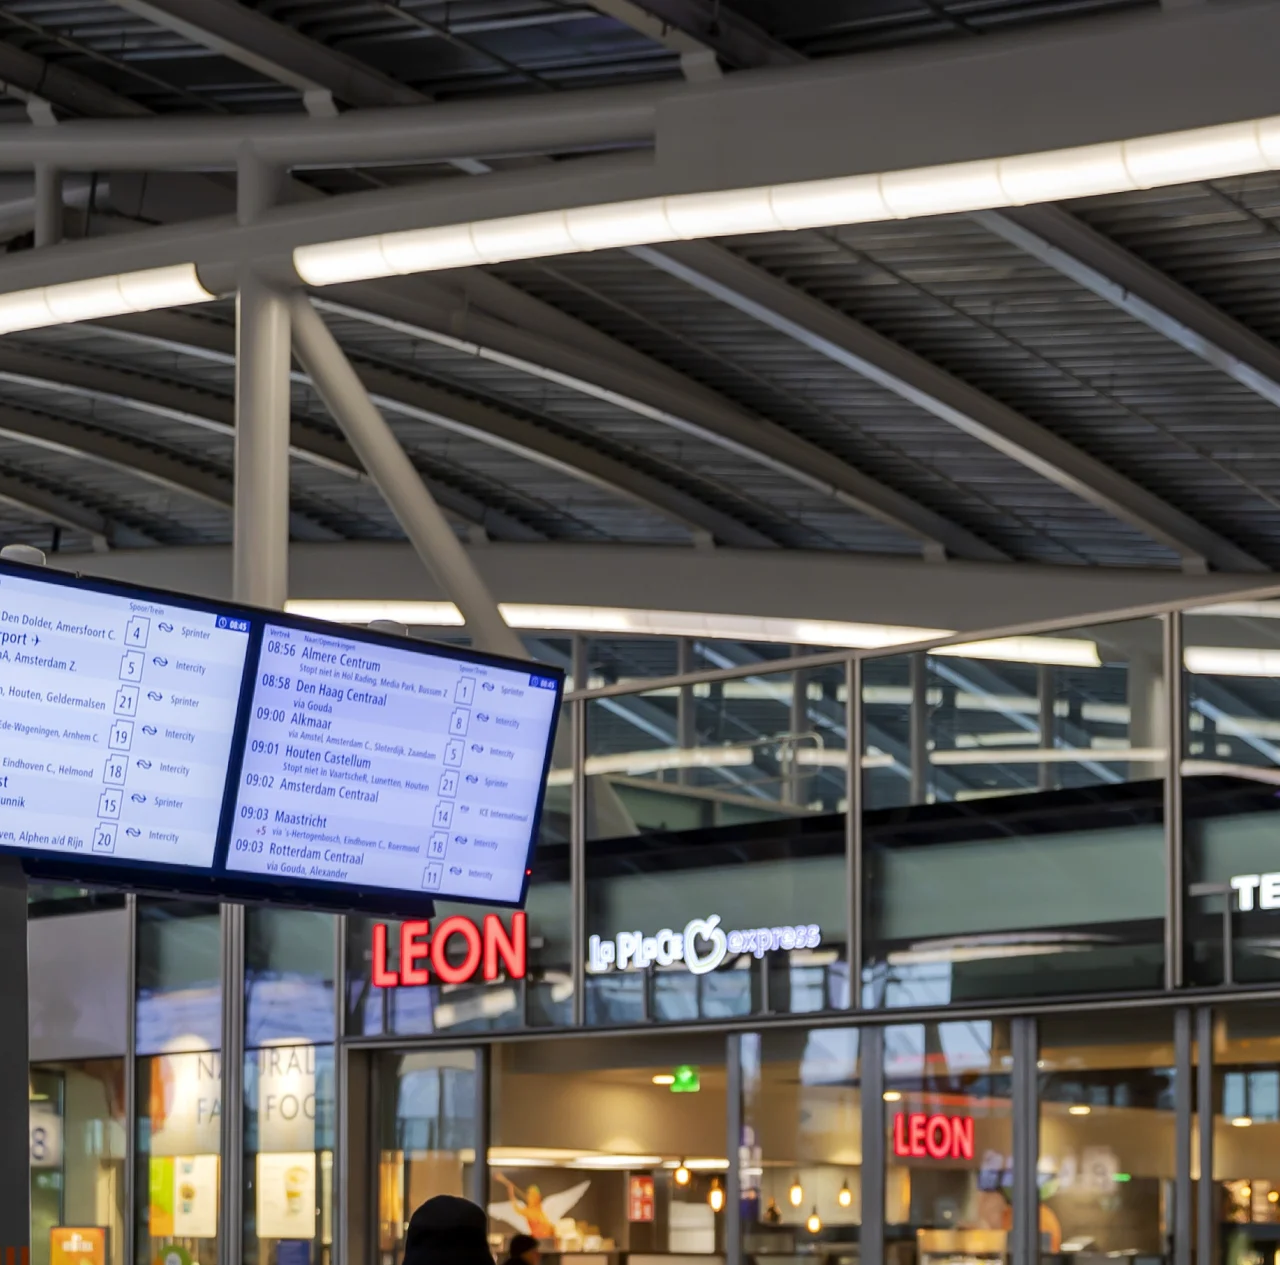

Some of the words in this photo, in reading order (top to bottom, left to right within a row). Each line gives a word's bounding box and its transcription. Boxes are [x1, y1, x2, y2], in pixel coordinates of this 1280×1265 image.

[133, 626, 141, 640] 4
[267, 639, 296, 657] 08:56
[127, 661, 135, 675] 5
[301, 646, 338, 665] Almere
[339, 653, 381, 673] Centrum
[261, 673, 291, 690] 08:58
[295, 678, 317, 695] Den
[318, 682, 345, 703] Haag
[346, 688, 388, 707] Centraal
[118, 695, 132, 710] 21
[256, 706, 286, 723] 09:00
[290, 711, 333, 731] Alkmaar
[115, 729, 128, 744] 19
[251, 739, 280, 756] 09:01
[285, 744, 322, 762] Houten
[323, 750, 372, 770] Castellum
[109, 764, 123, 779] 18
[245, 772, 275, 789] 09:02
[279, 777, 337, 797] Amsterdam
[338, 785, 380, 803] Centraal
[104, 798, 117, 813] 15
[240, 805, 270, 821] 09:03
[274, 809, 328, 829] Maastricht
[97, 832, 112, 847] 20
[235, 838, 264, 854] 09:03
[269, 841, 322, 861] Rotterdam
[323, 848, 365, 866] Centraal
[372, 911, 527, 989] LEON
[726, 924, 821, 960] express
[894, 1112, 975, 1161] LEON
